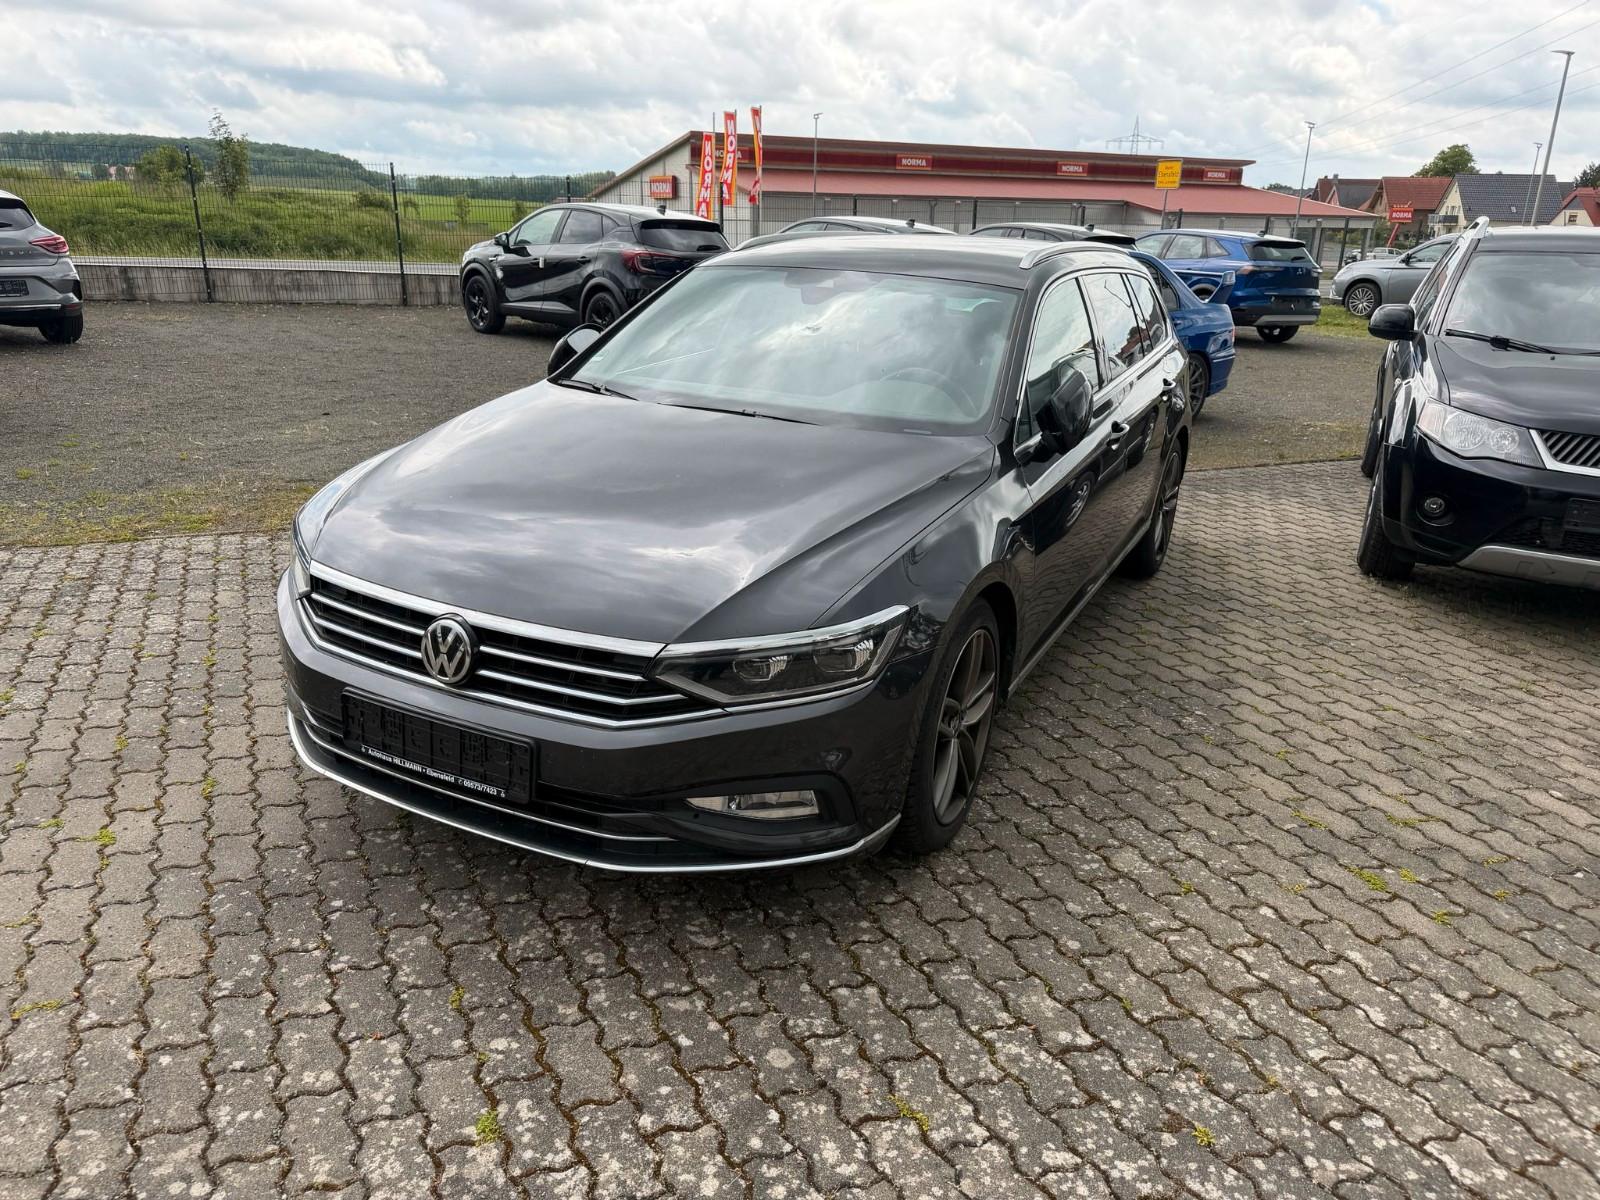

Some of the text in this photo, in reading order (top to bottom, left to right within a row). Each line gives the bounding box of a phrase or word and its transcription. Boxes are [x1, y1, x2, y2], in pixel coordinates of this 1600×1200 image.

[722, 119, 735, 200] NORMA
[901, 158, 927, 167] NORMA
[1061, 165, 1083, 173] NORMA
[651, 182, 672, 193] NORMA
[699, 141, 712, 218] NORMA
[368, 748, 392, 762] Autohaus
[393, 757, 422, 772] HILLMANN
